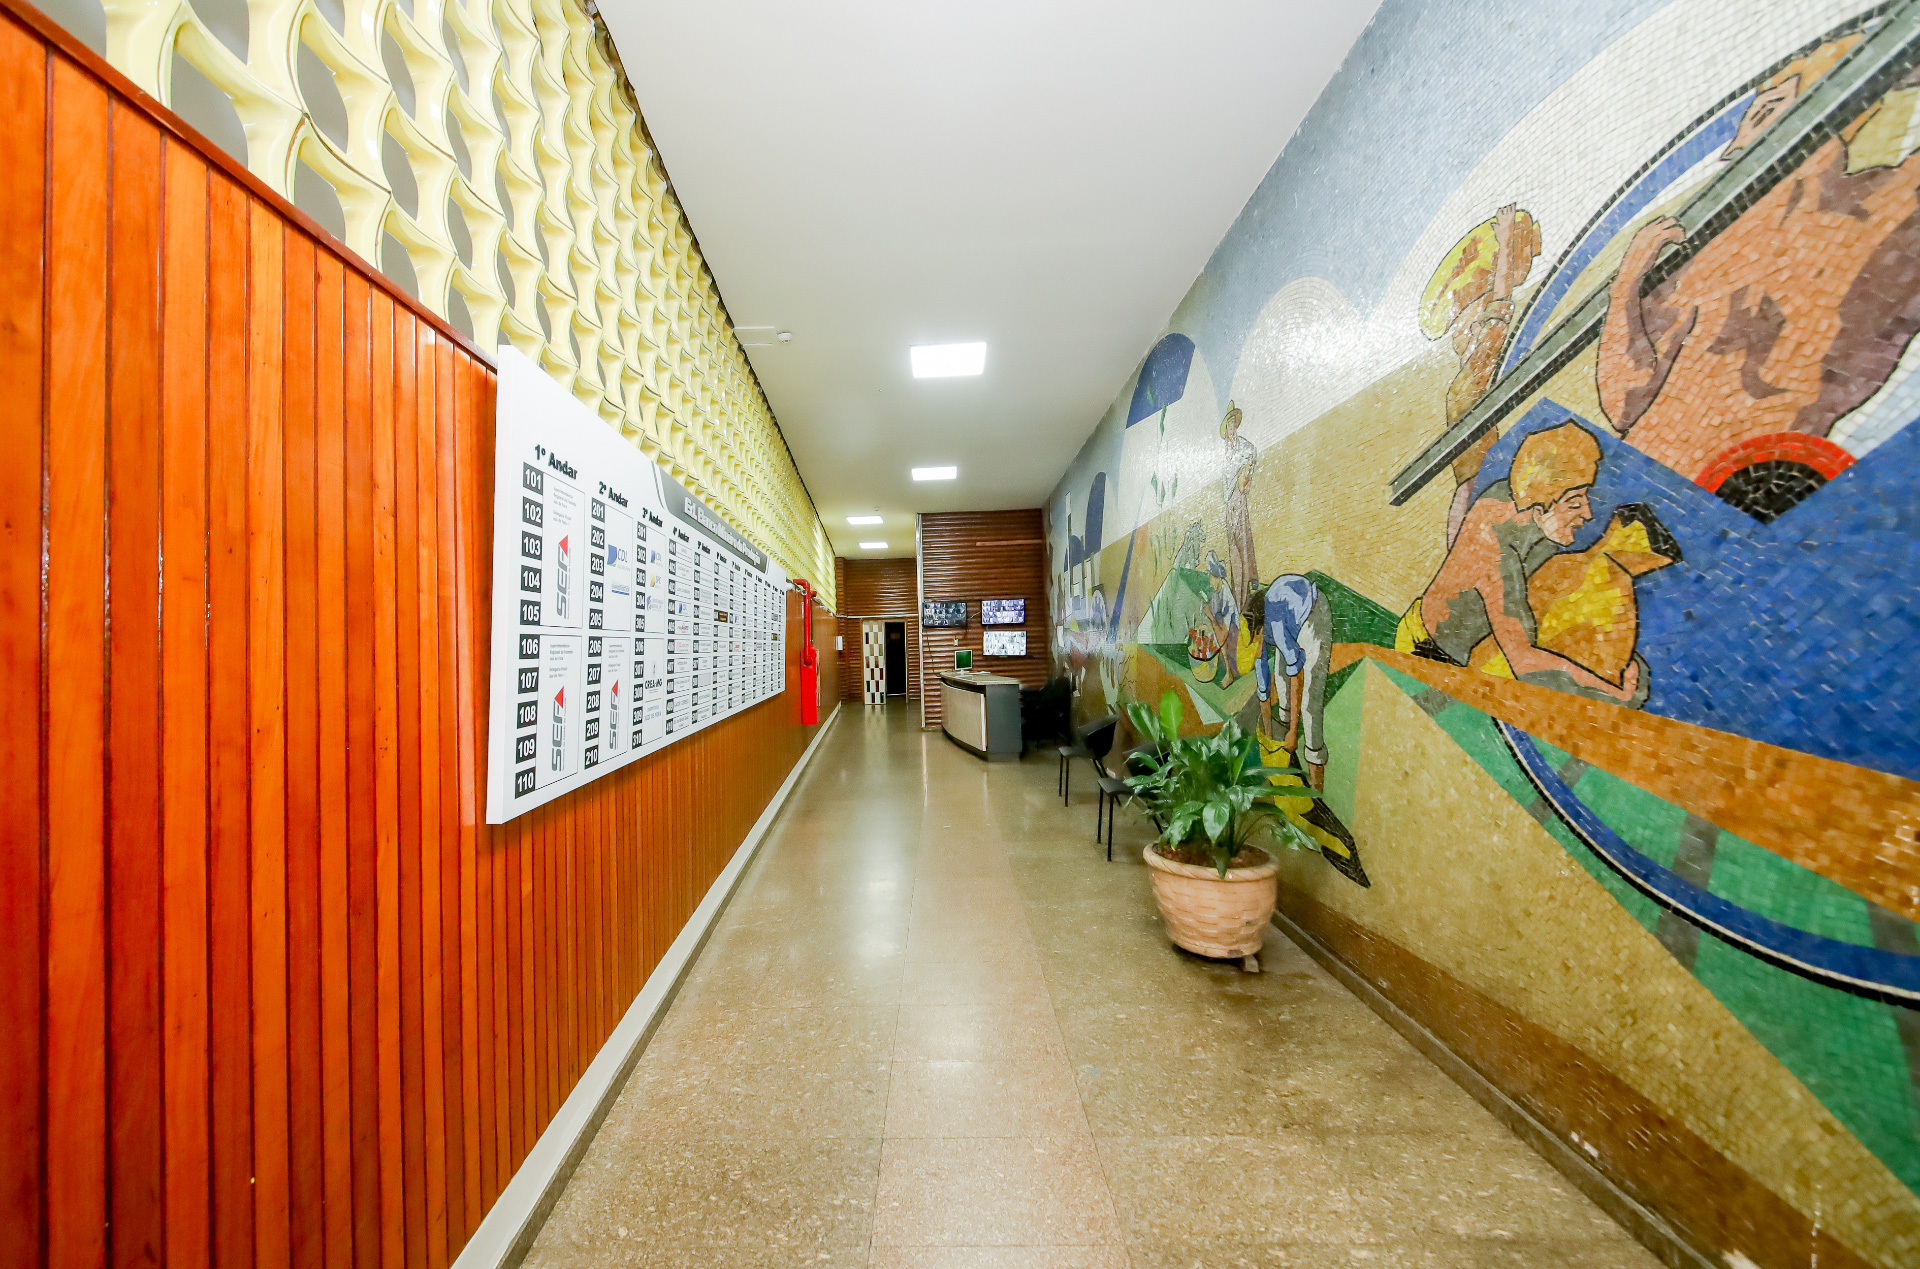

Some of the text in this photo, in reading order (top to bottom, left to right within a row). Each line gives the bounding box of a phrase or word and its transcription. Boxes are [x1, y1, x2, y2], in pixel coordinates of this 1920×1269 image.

[548, 452, 578, 480] Andar
[526, 468, 541, 490] 101
[608, 486, 628, 508] Andar
[525, 502, 541, 522] 102
[592, 502, 604, 519] 201
[684, 496, 697, 520] Ed.
[649, 511, 663, 528] Andar
[592, 529, 604, 546] 202
[523, 537, 540, 556] 103
[618, 548, 628, 562] CDL
[591, 557, 604, 572] 203
[523, 570, 540, 588] 104
[590, 585, 603, 599] 204
[522, 604, 539, 621] 105
[590, 613, 602, 626] 205
[521, 638, 538, 655] 106
[589, 640, 601, 654] 206
[588, 668, 600, 681] 207
[635, 664, 643, 676] 307
[520, 672, 538, 689] 107
[644, 678, 662, 690] CREA-MG
[587, 694, 599, 709] 208
[519, 705, 536, 724] 108
[586, 722, 599, 737] 209
[518, 738, 535, 757] 109
[632, 732, 642, 746] 310
[585, 749, 598, 766] 210
[517, 772, 534, 792] 110
